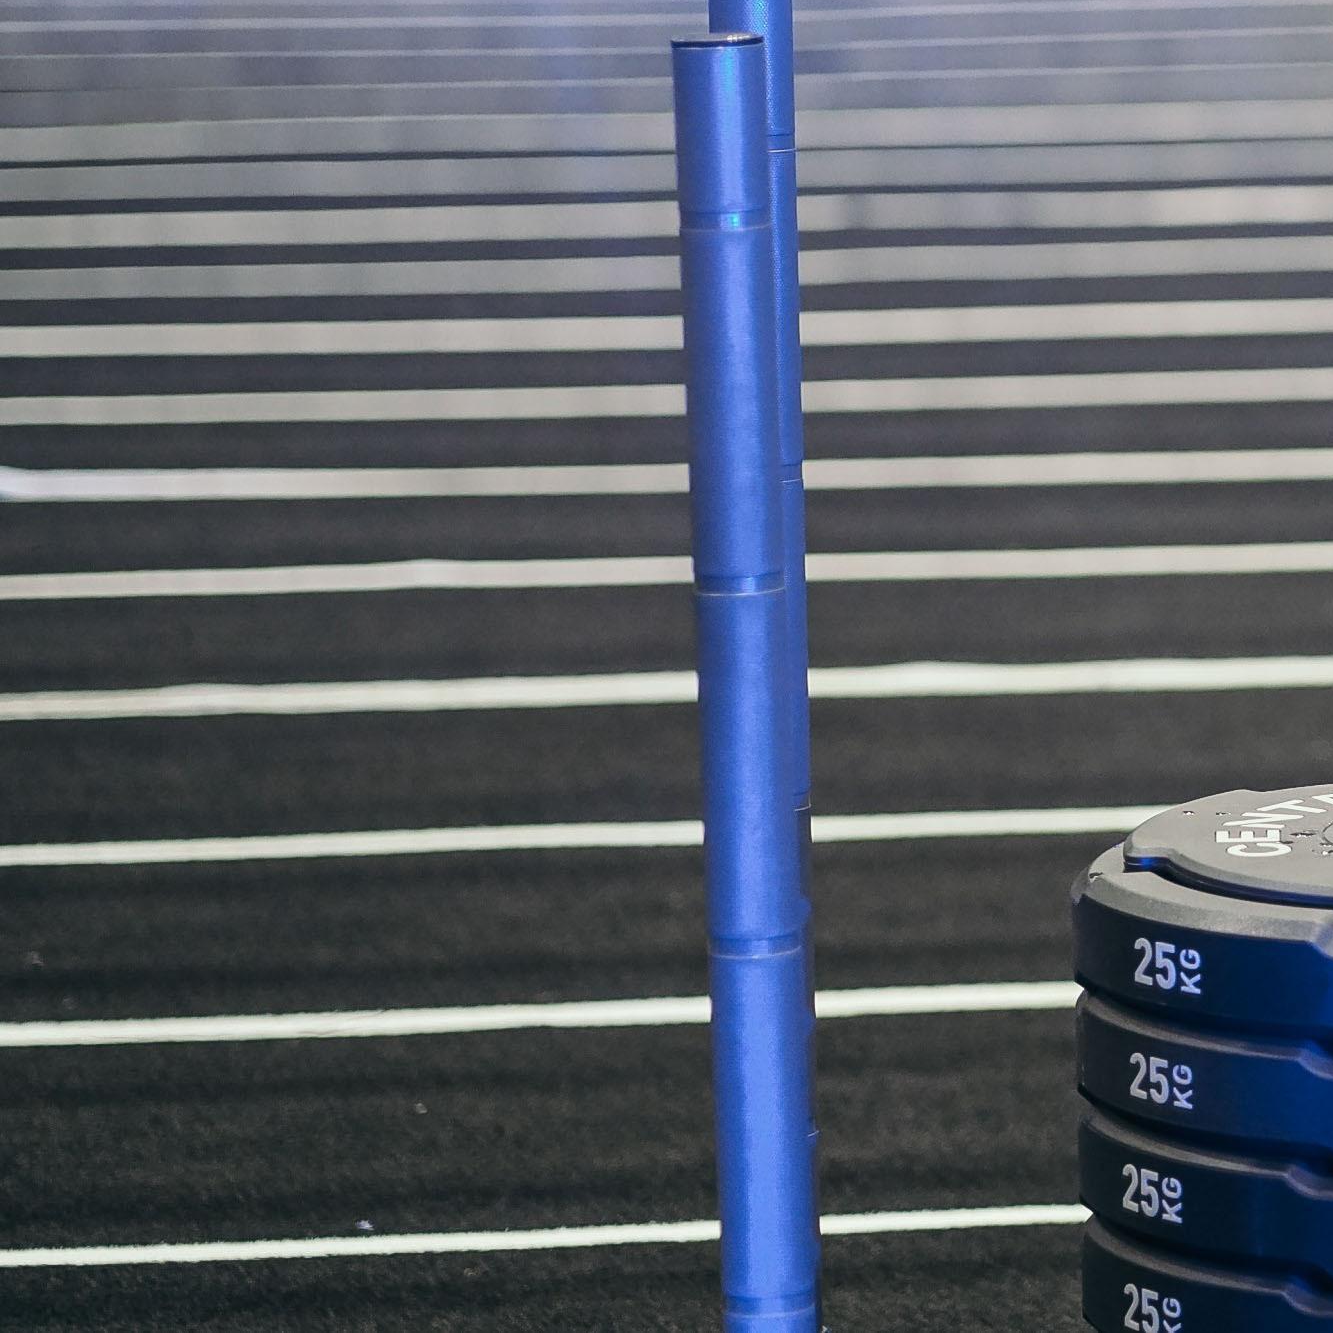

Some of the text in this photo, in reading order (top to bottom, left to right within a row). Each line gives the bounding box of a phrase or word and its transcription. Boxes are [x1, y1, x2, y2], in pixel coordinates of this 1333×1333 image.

[1134, 937, 1201, 995] 25 KG
[1129, 1052, 1193, 1110] 25 KG
[1122, 1163, 1183, 1224] 25 KG
[1123, 1283, 1160, 1333] 25
